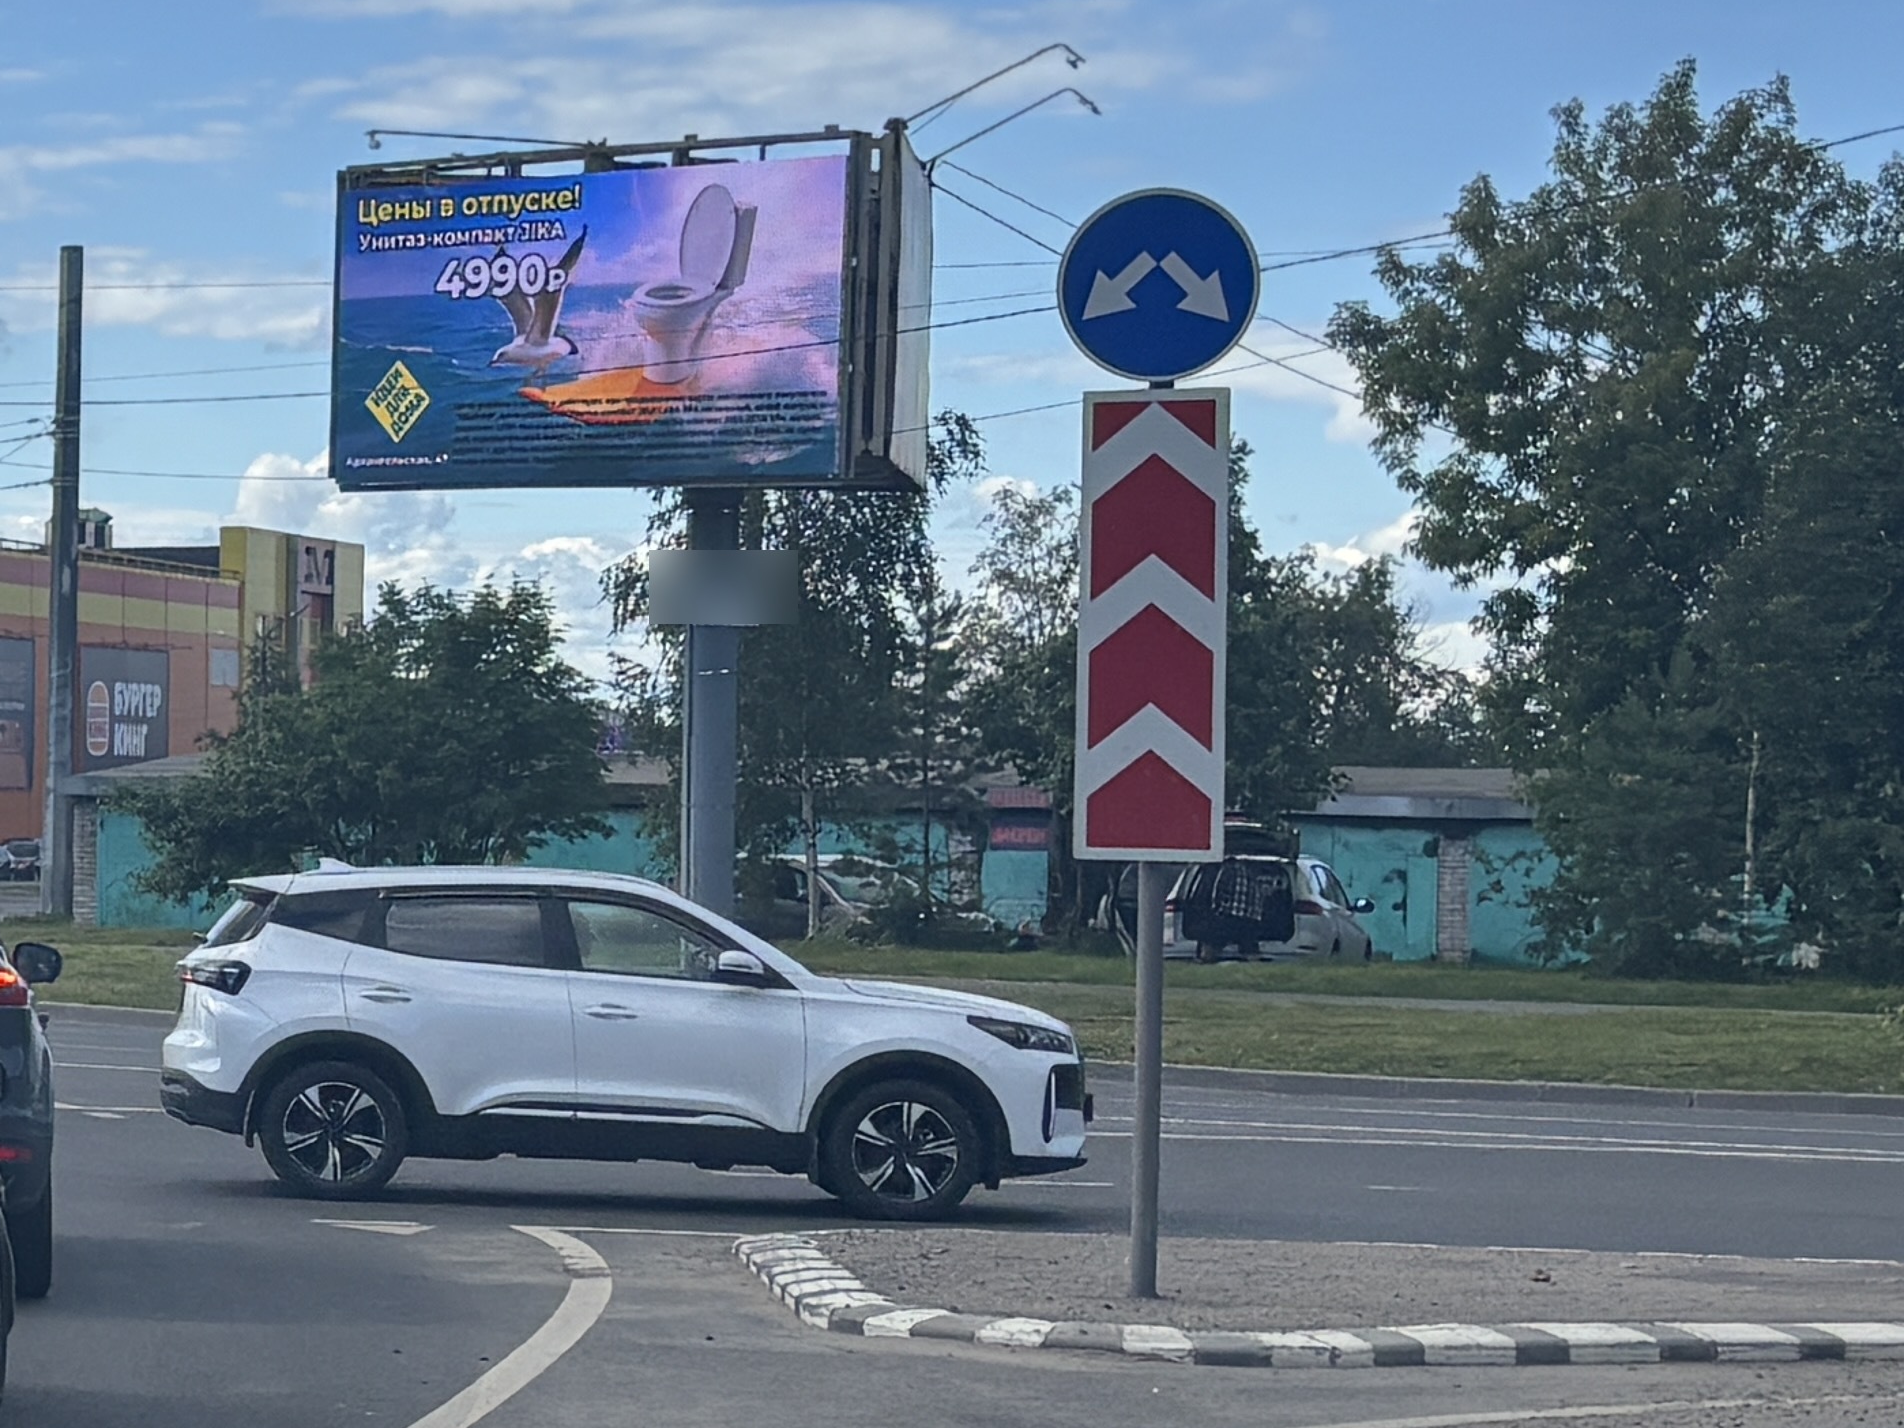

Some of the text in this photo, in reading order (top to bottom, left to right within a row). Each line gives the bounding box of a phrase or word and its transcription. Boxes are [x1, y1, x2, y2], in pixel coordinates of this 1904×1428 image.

[358, 184, 581, 227] Цены в отпуске!
[358, 224, 515, 252] Унитаз-компакт
[114, 681, 162, 717] БУРГЕР
[113, 723, 148, 757] КИНГ
